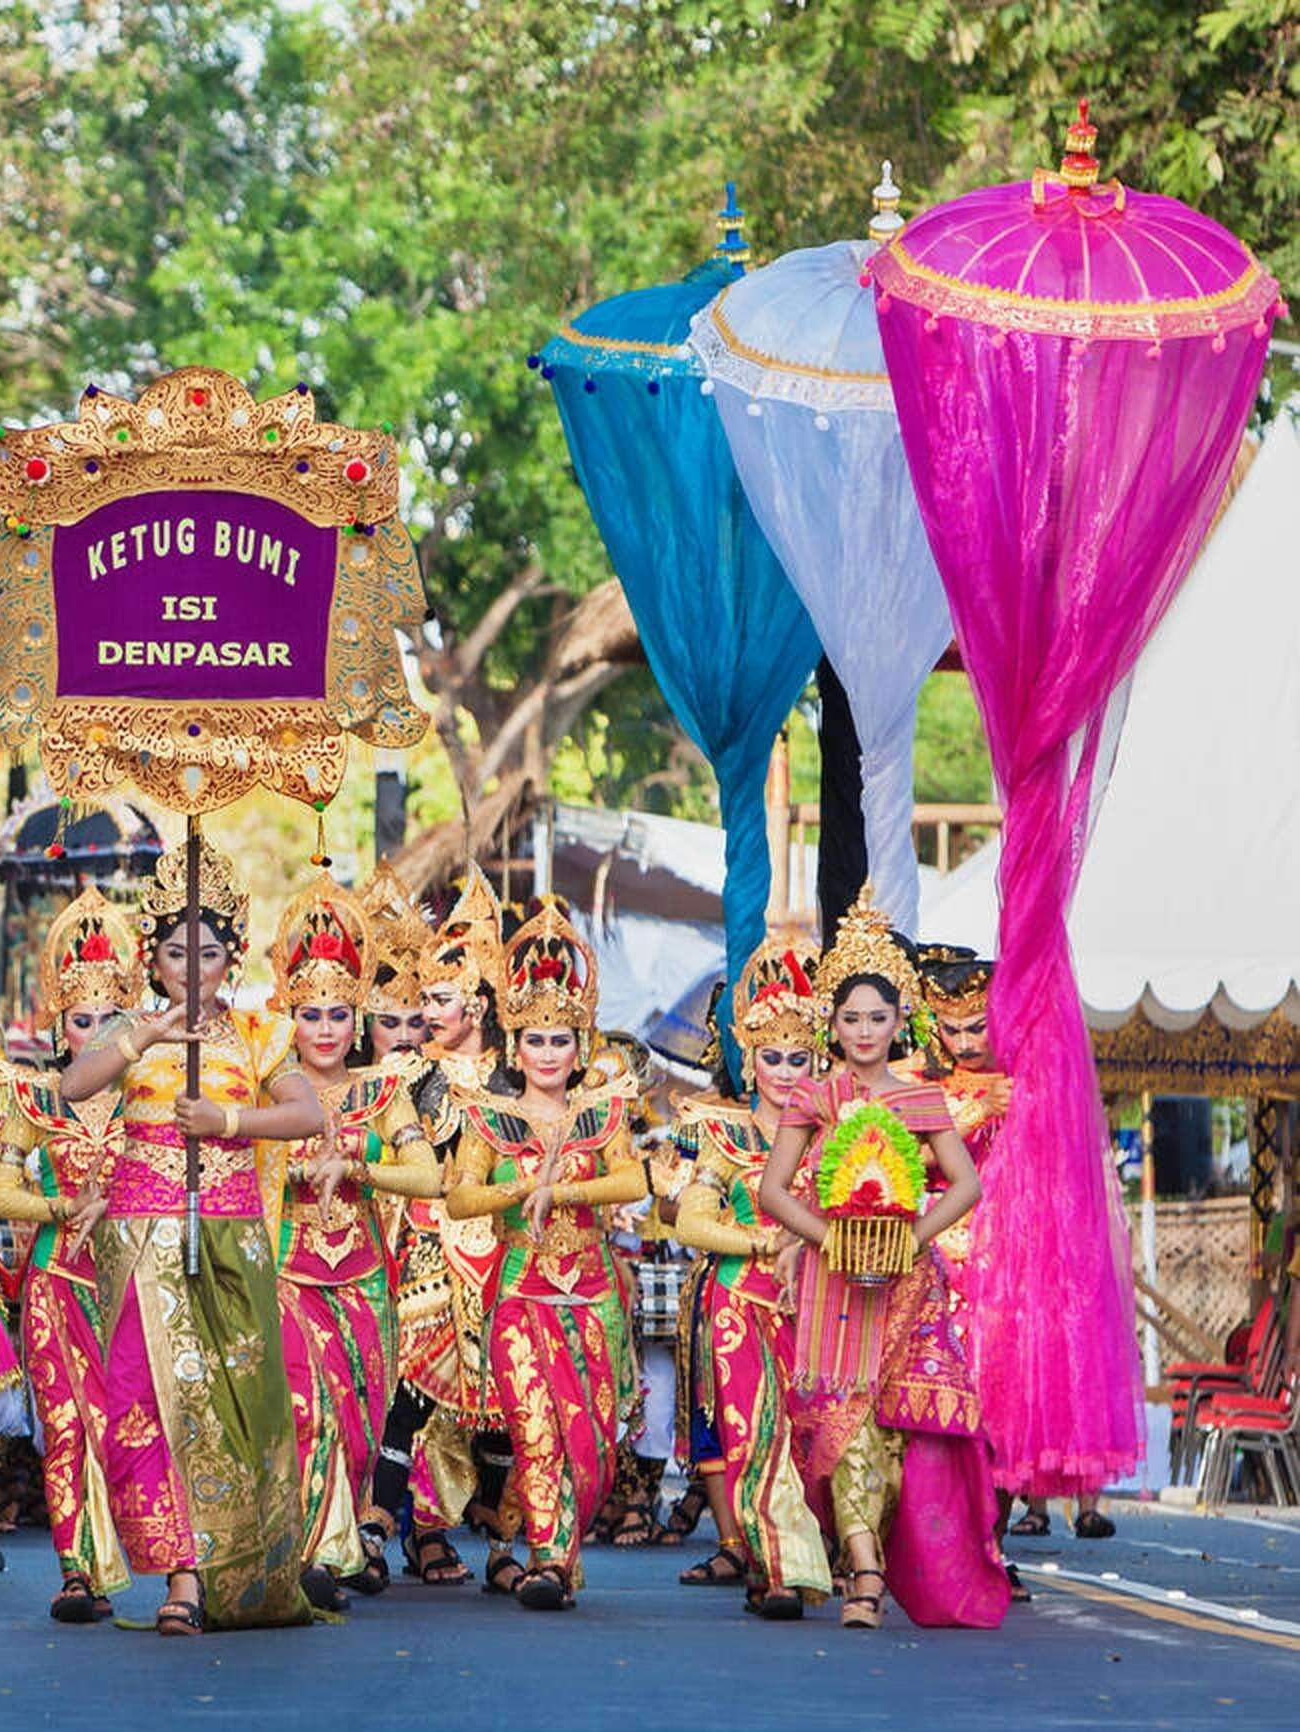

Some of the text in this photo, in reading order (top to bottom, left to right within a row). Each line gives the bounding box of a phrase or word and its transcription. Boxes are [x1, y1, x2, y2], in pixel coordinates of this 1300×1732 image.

[87, 518, 300, 586] KETUG BUMI
[161, 596, 218, 620] ISI
[98, 641, 292, 666] DENPASAR
